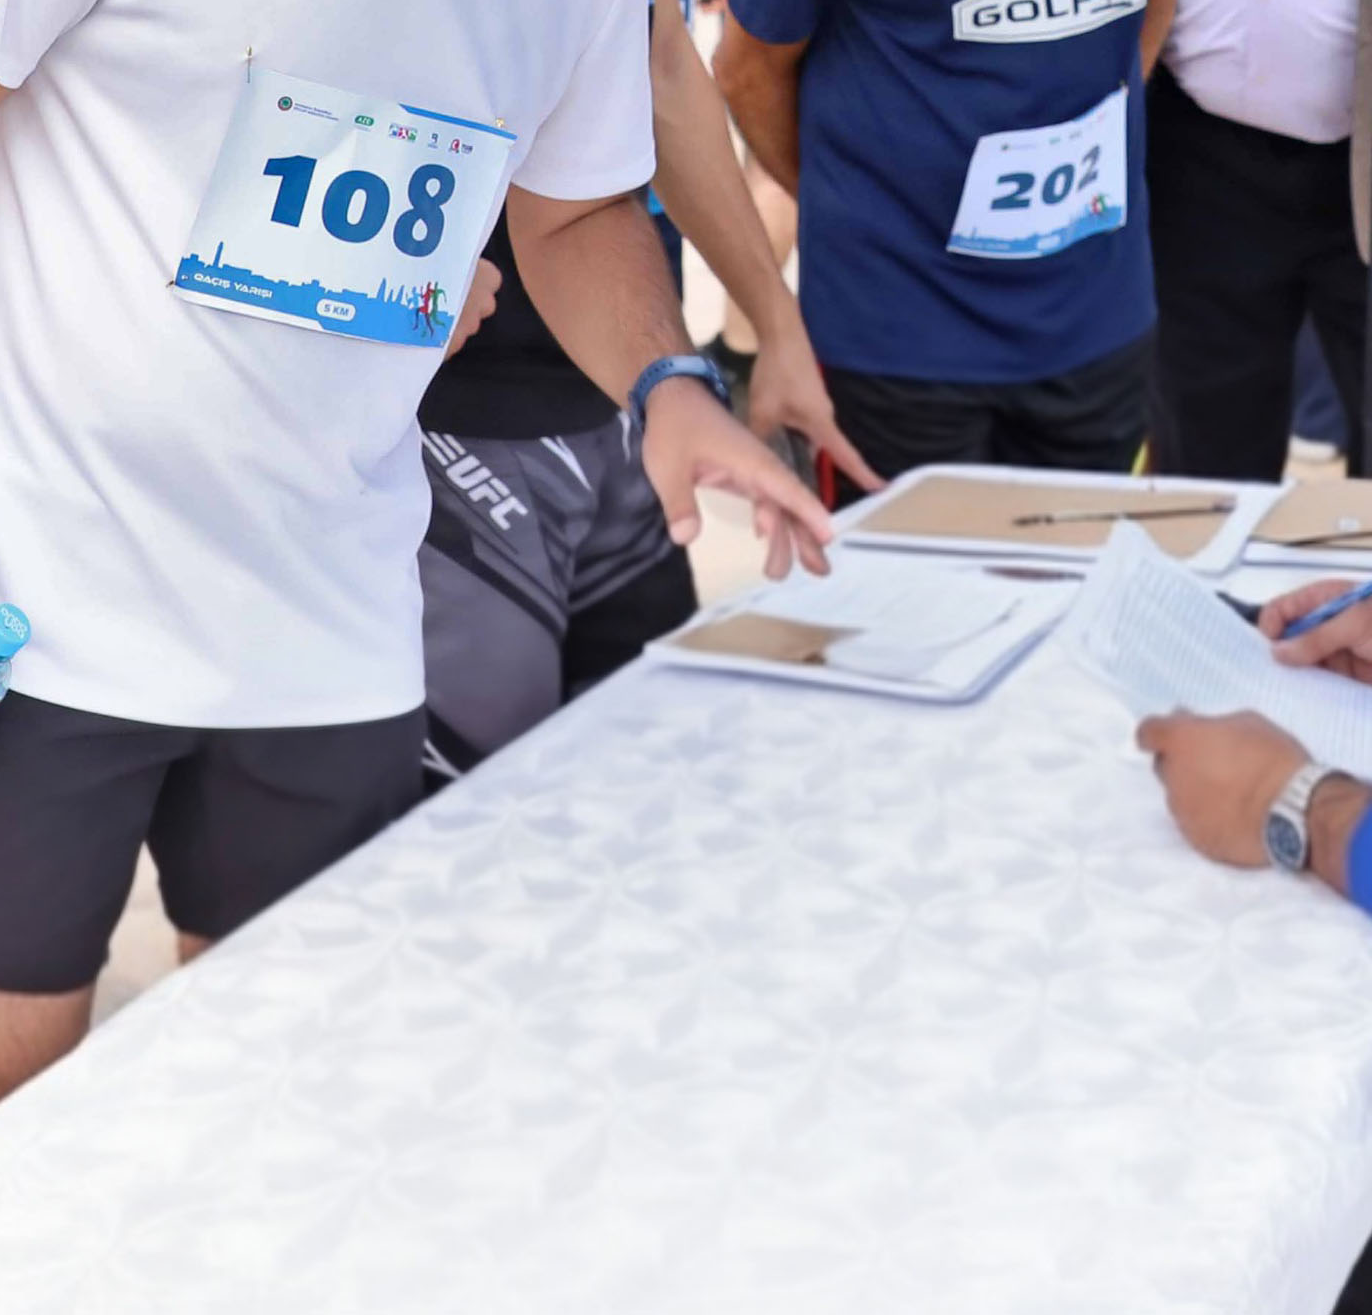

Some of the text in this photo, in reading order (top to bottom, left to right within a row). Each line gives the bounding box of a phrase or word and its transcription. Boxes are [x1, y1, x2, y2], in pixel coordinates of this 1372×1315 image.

[262, 155, 456, 258] 108
[990, 145, 1101, 210] 202
[324, 303, 350, 317] 5 KM
[445, 454, 528, 530] UFC
